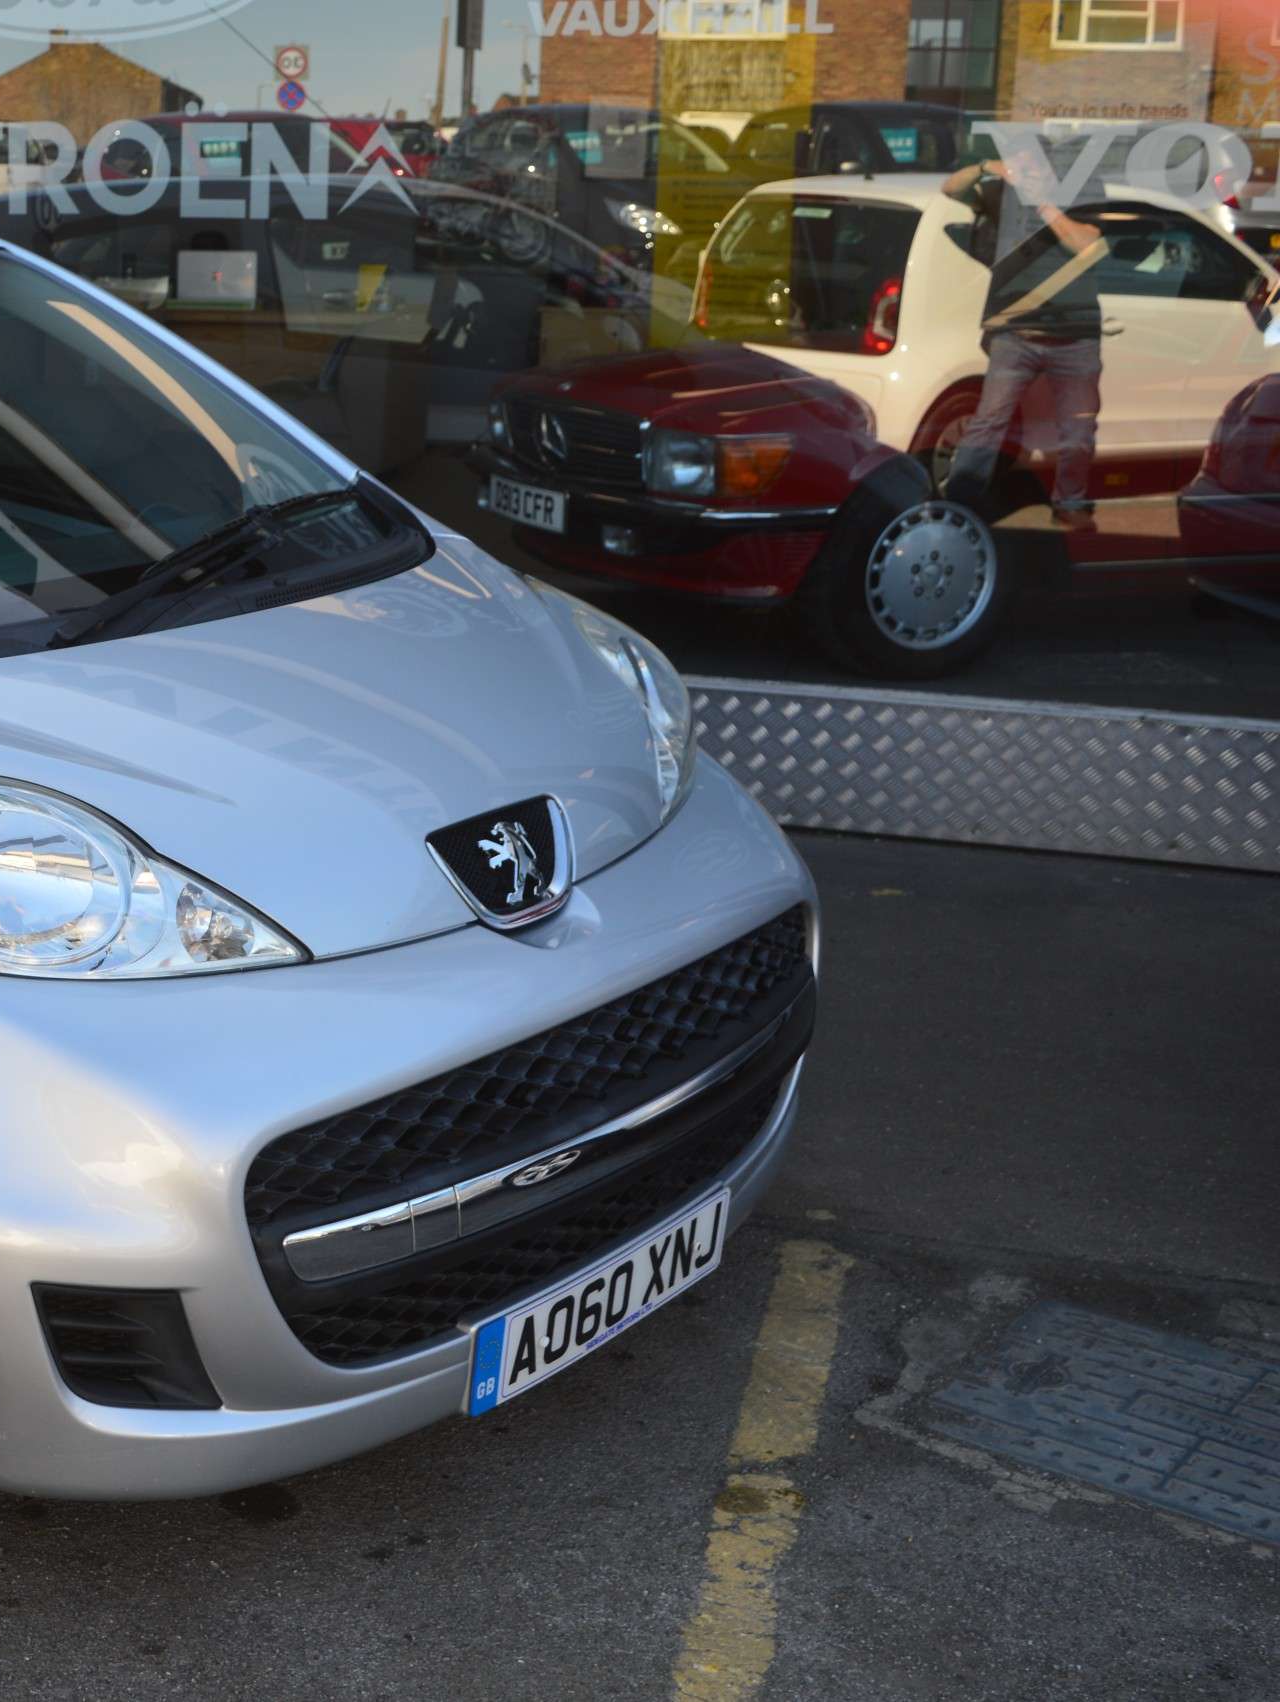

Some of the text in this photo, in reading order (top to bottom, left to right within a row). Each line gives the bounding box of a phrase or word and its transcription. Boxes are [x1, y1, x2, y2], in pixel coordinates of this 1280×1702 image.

[508, 1201, 723, 1385] AO60 XNJ
[477, 1376, 495, 1400] GB
